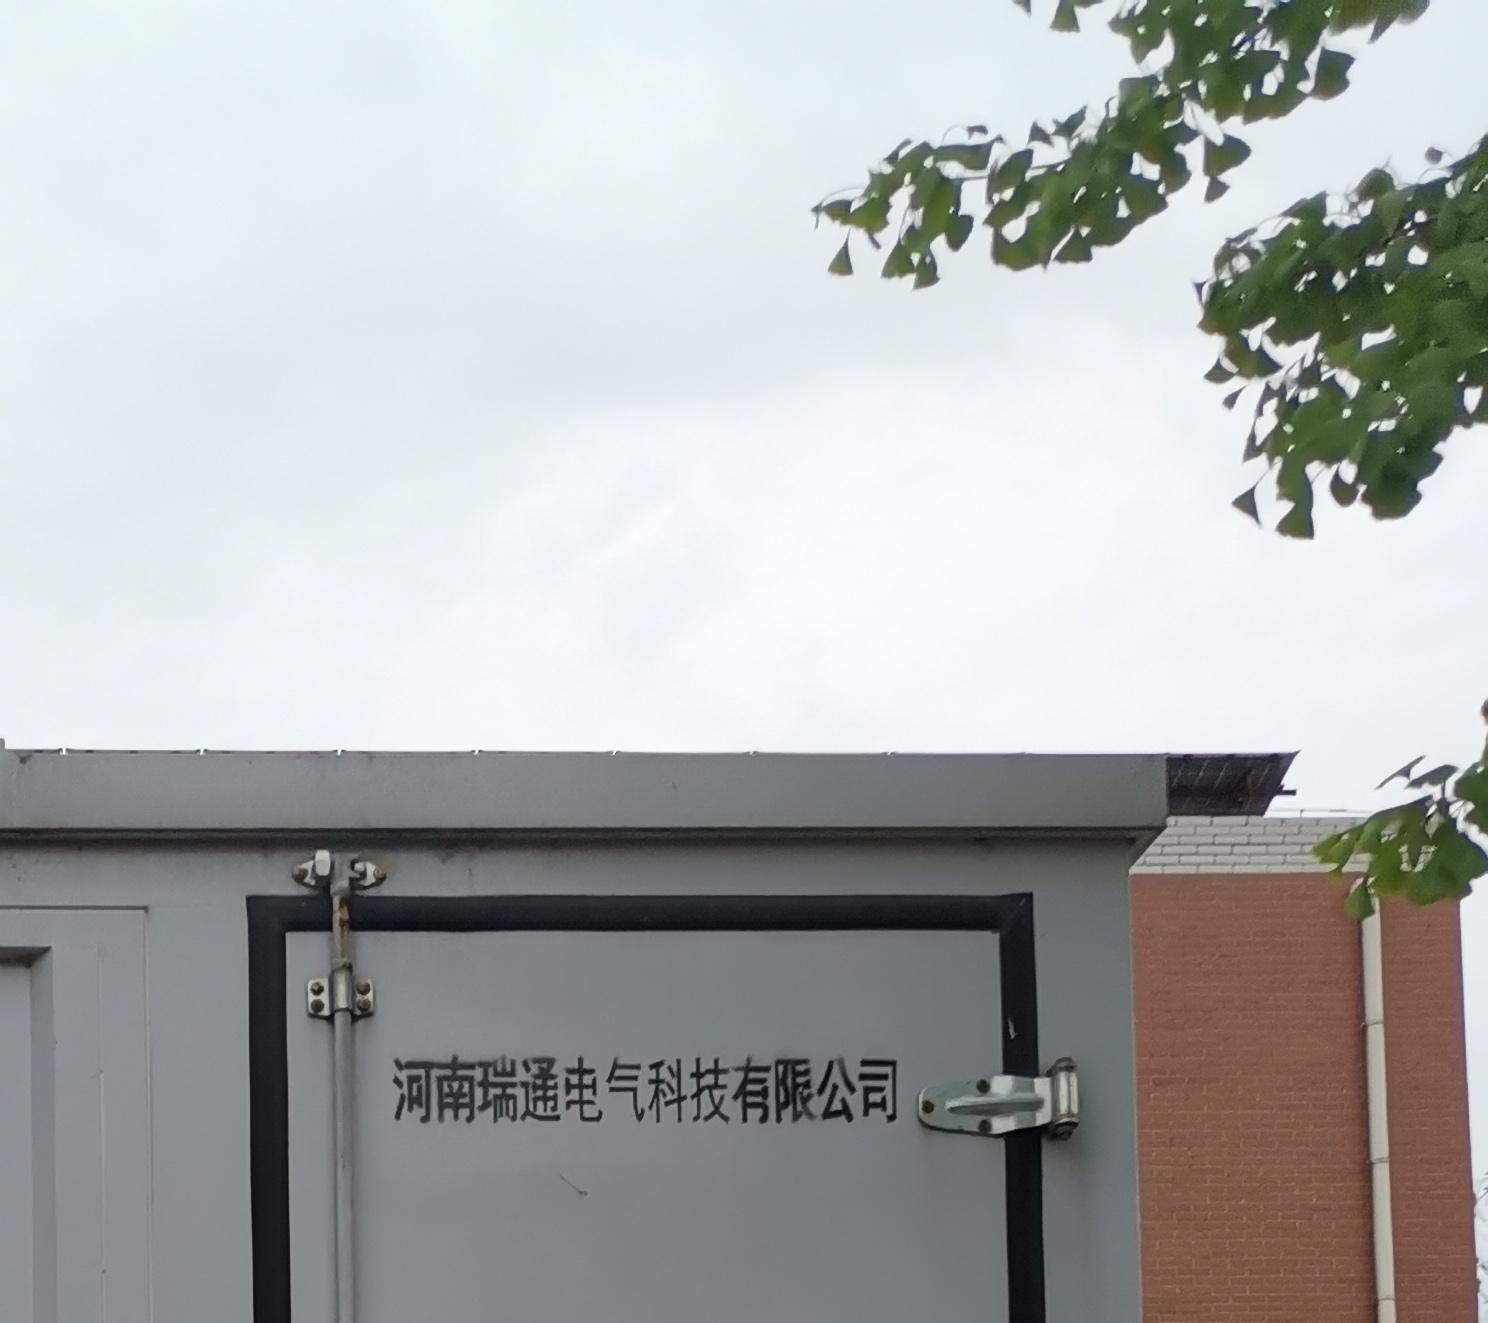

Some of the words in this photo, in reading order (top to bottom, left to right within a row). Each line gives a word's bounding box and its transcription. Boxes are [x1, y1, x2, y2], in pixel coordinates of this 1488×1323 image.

[393, 1055, 898, 1123] 河南瑞通电气科技有限公司
